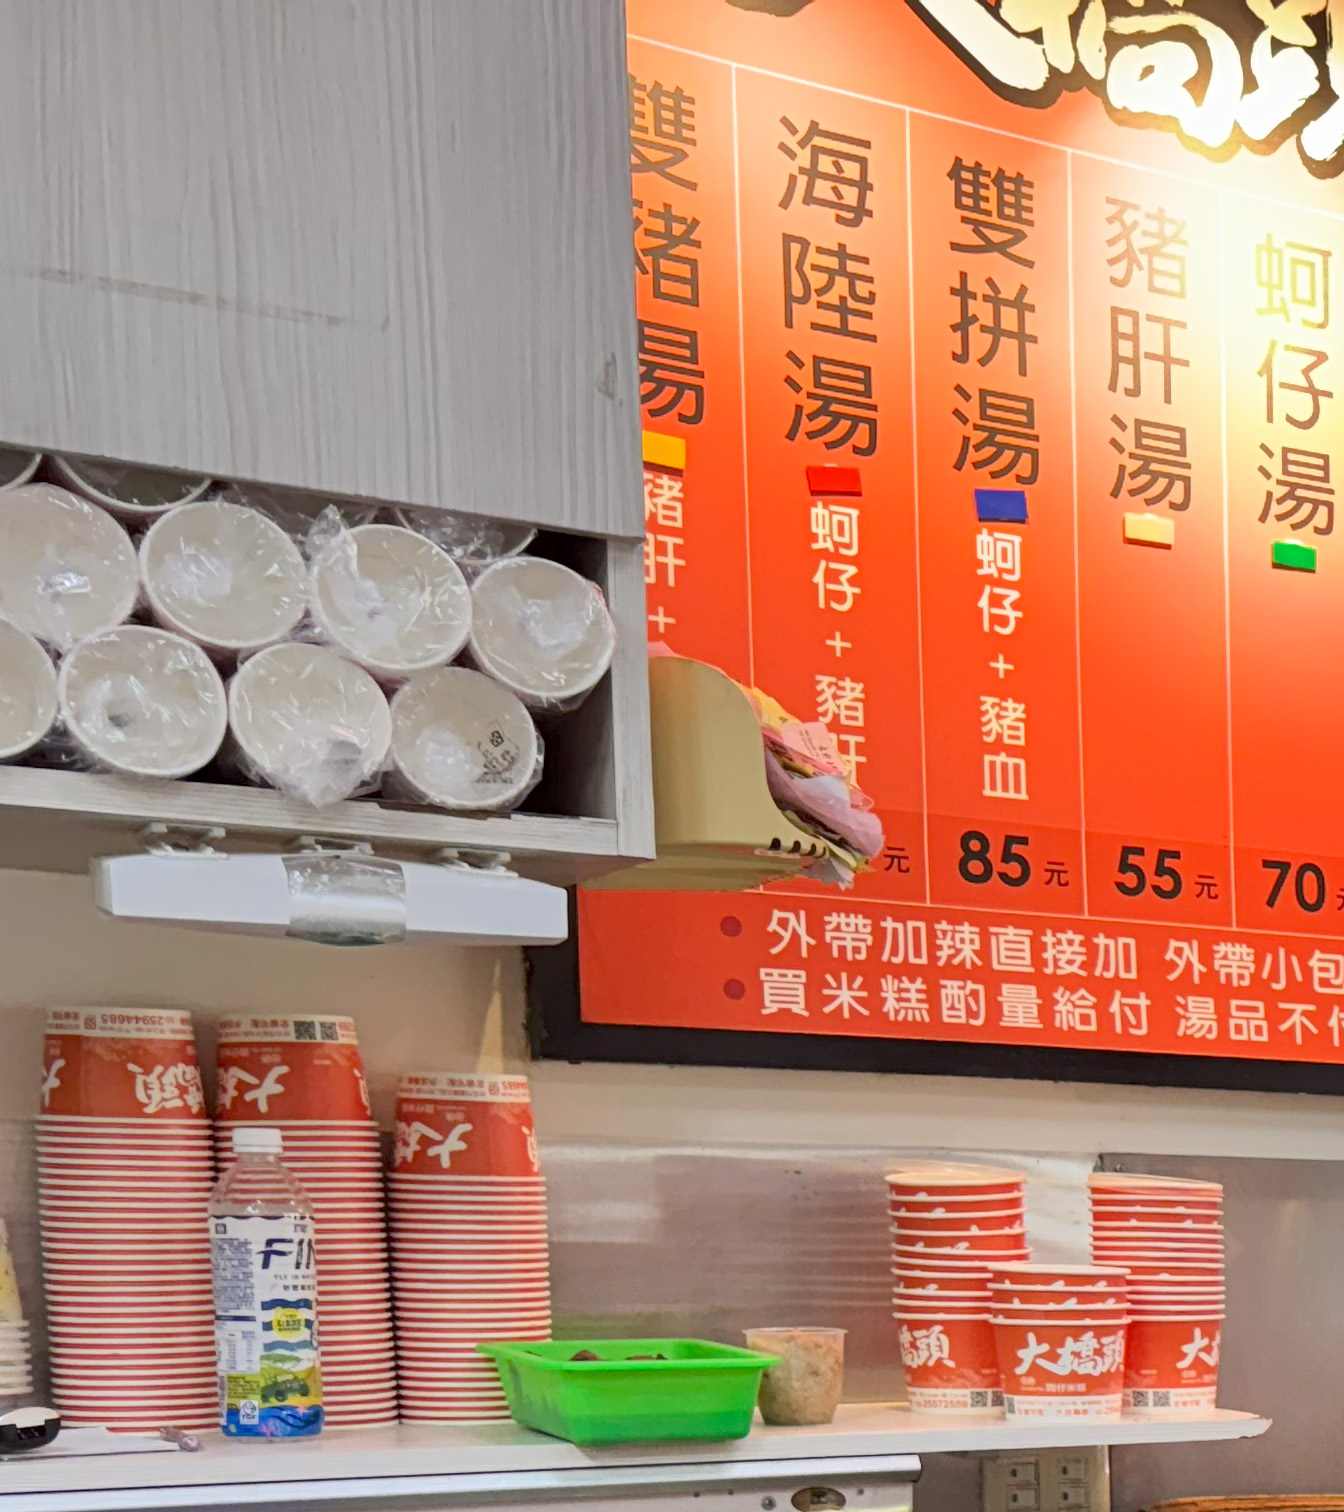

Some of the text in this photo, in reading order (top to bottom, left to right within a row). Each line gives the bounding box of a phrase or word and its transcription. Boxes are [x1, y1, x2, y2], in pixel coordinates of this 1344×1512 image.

[776, 116, 878, 459] 海陸湯
[947, 157, 1040, 486] 雙拼湯
[1105, 196, 1193, 512] 豬肝湯
[1254, 234, 1337, 537] 蚵仔湯
[758, 967, 1151, 1039] 買米糕酌量給付
[765, 907, 1139, 981] 外帶加辣直接加
